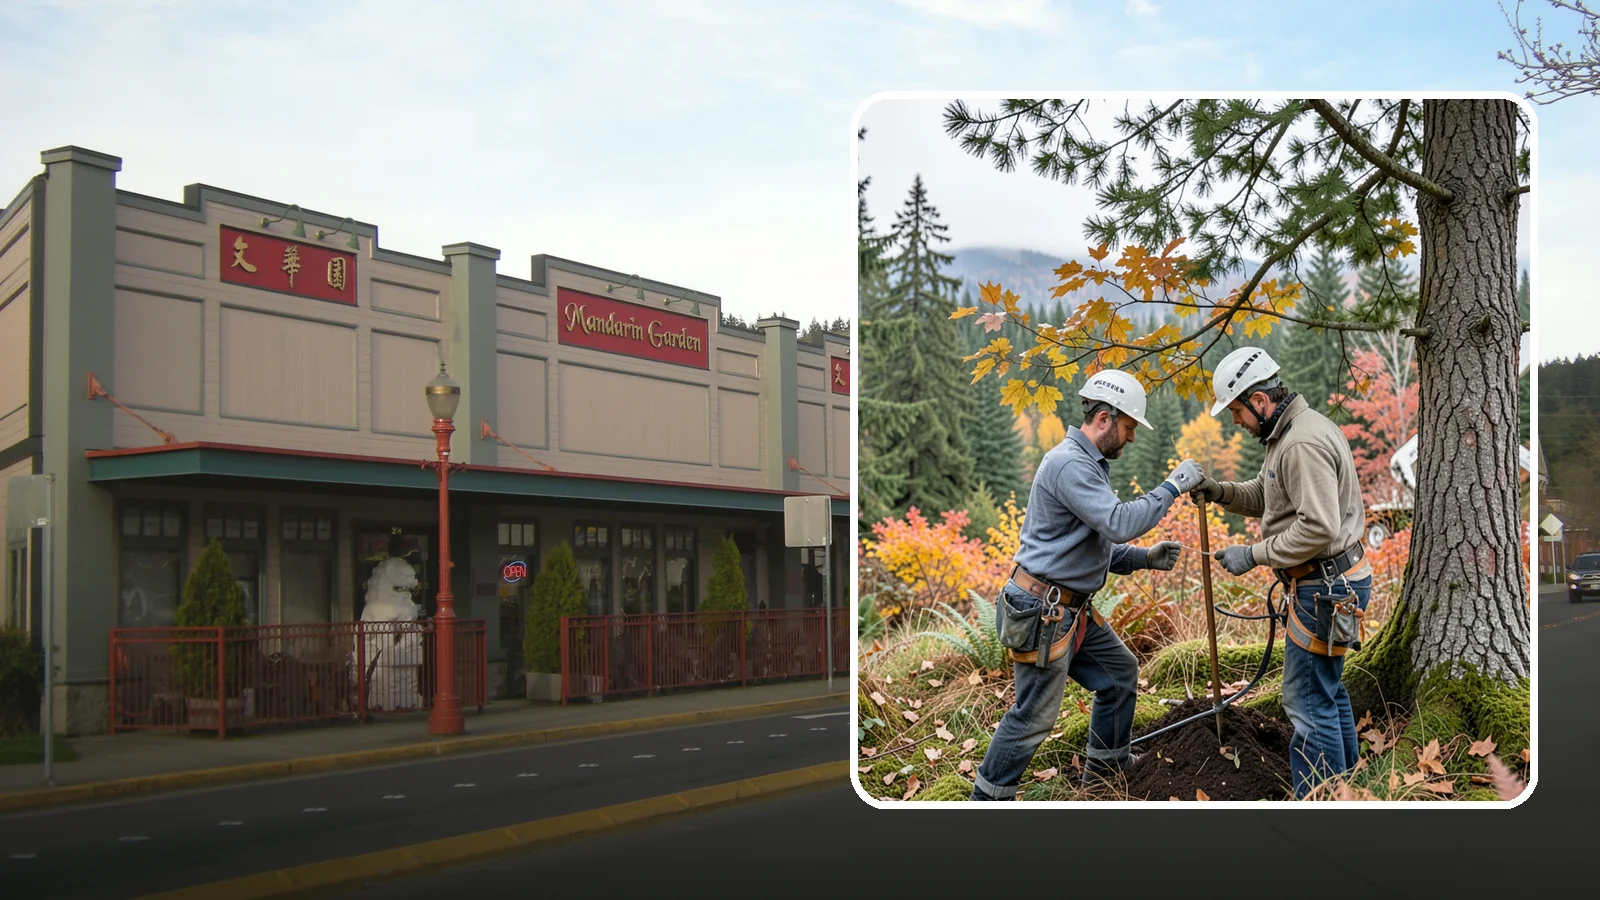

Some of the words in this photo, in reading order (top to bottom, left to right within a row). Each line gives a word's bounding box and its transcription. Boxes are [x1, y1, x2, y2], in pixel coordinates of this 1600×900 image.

[231, 235, 346, 290] 文華園
[564, 302, 644, 341] Mandarin
[648, 320, 701, 352] Garden
[503, 565, 527, 578] OPEN
